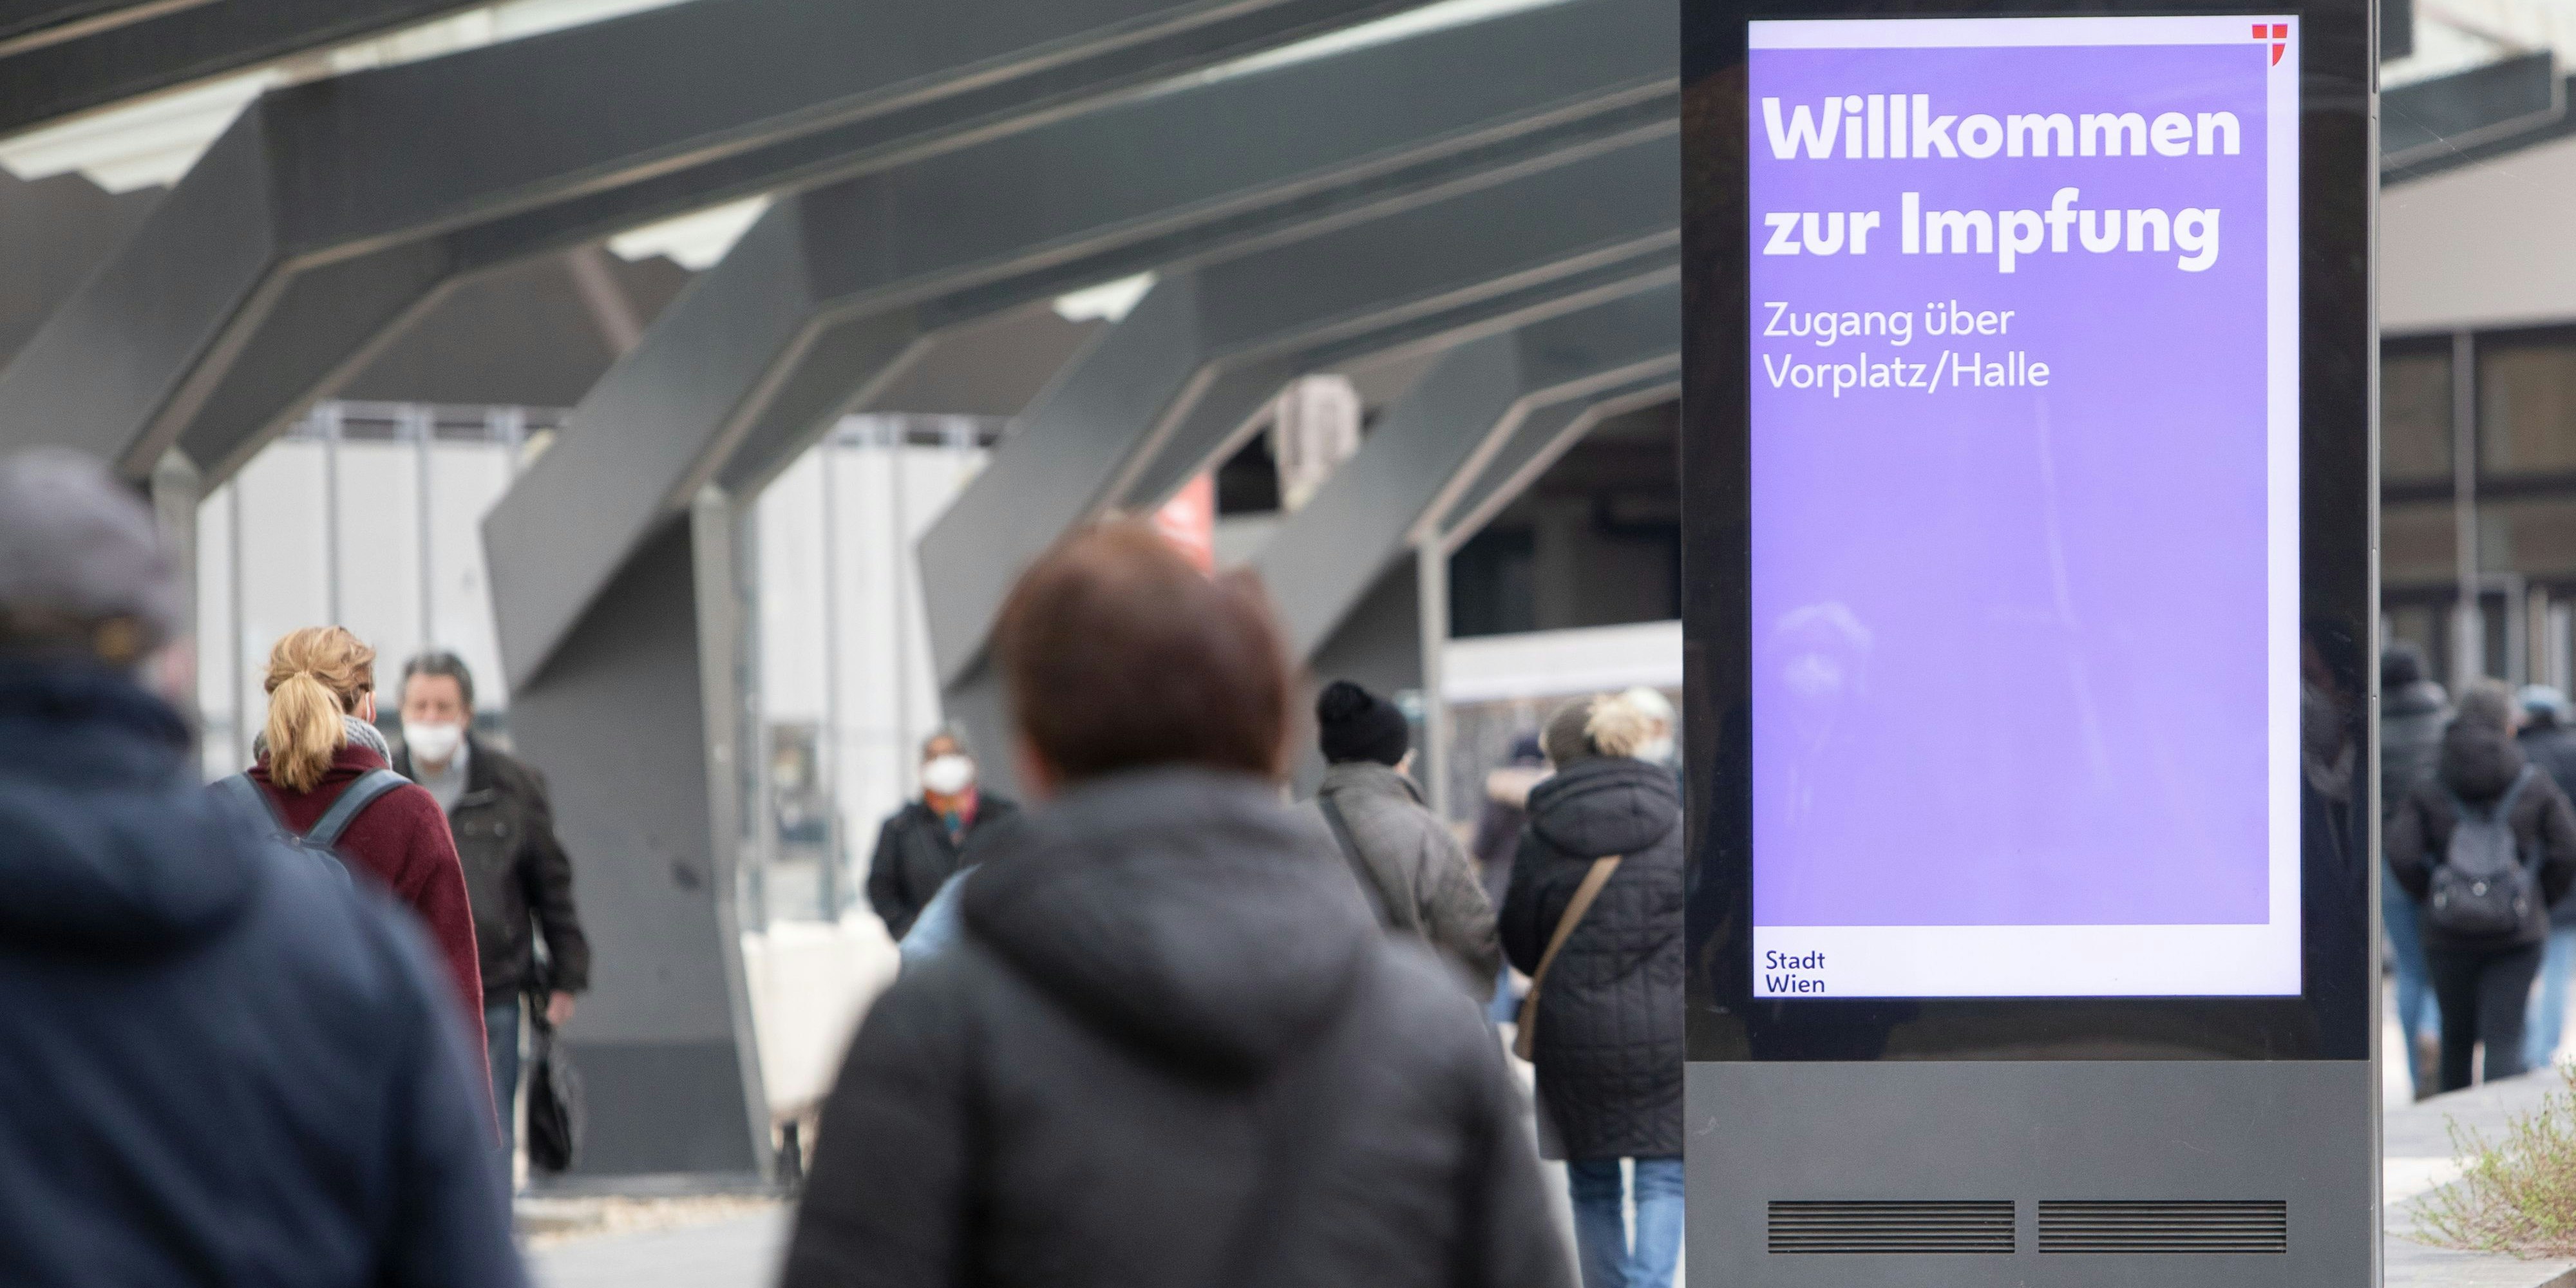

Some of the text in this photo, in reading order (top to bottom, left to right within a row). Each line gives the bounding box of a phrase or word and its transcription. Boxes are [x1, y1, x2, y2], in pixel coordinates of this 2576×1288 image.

[1762, 93, 2240, 159] Willkommen
[1763, 187, 2221, 273] zur Impfung
[1763, 300, 2015, 346] Zugang über
[1763, 350, 2050, 398] Vorplatz/Halle
[1765, 950, 1826, 970] Stadt
[1765, 974, 1825, 993] Wien
